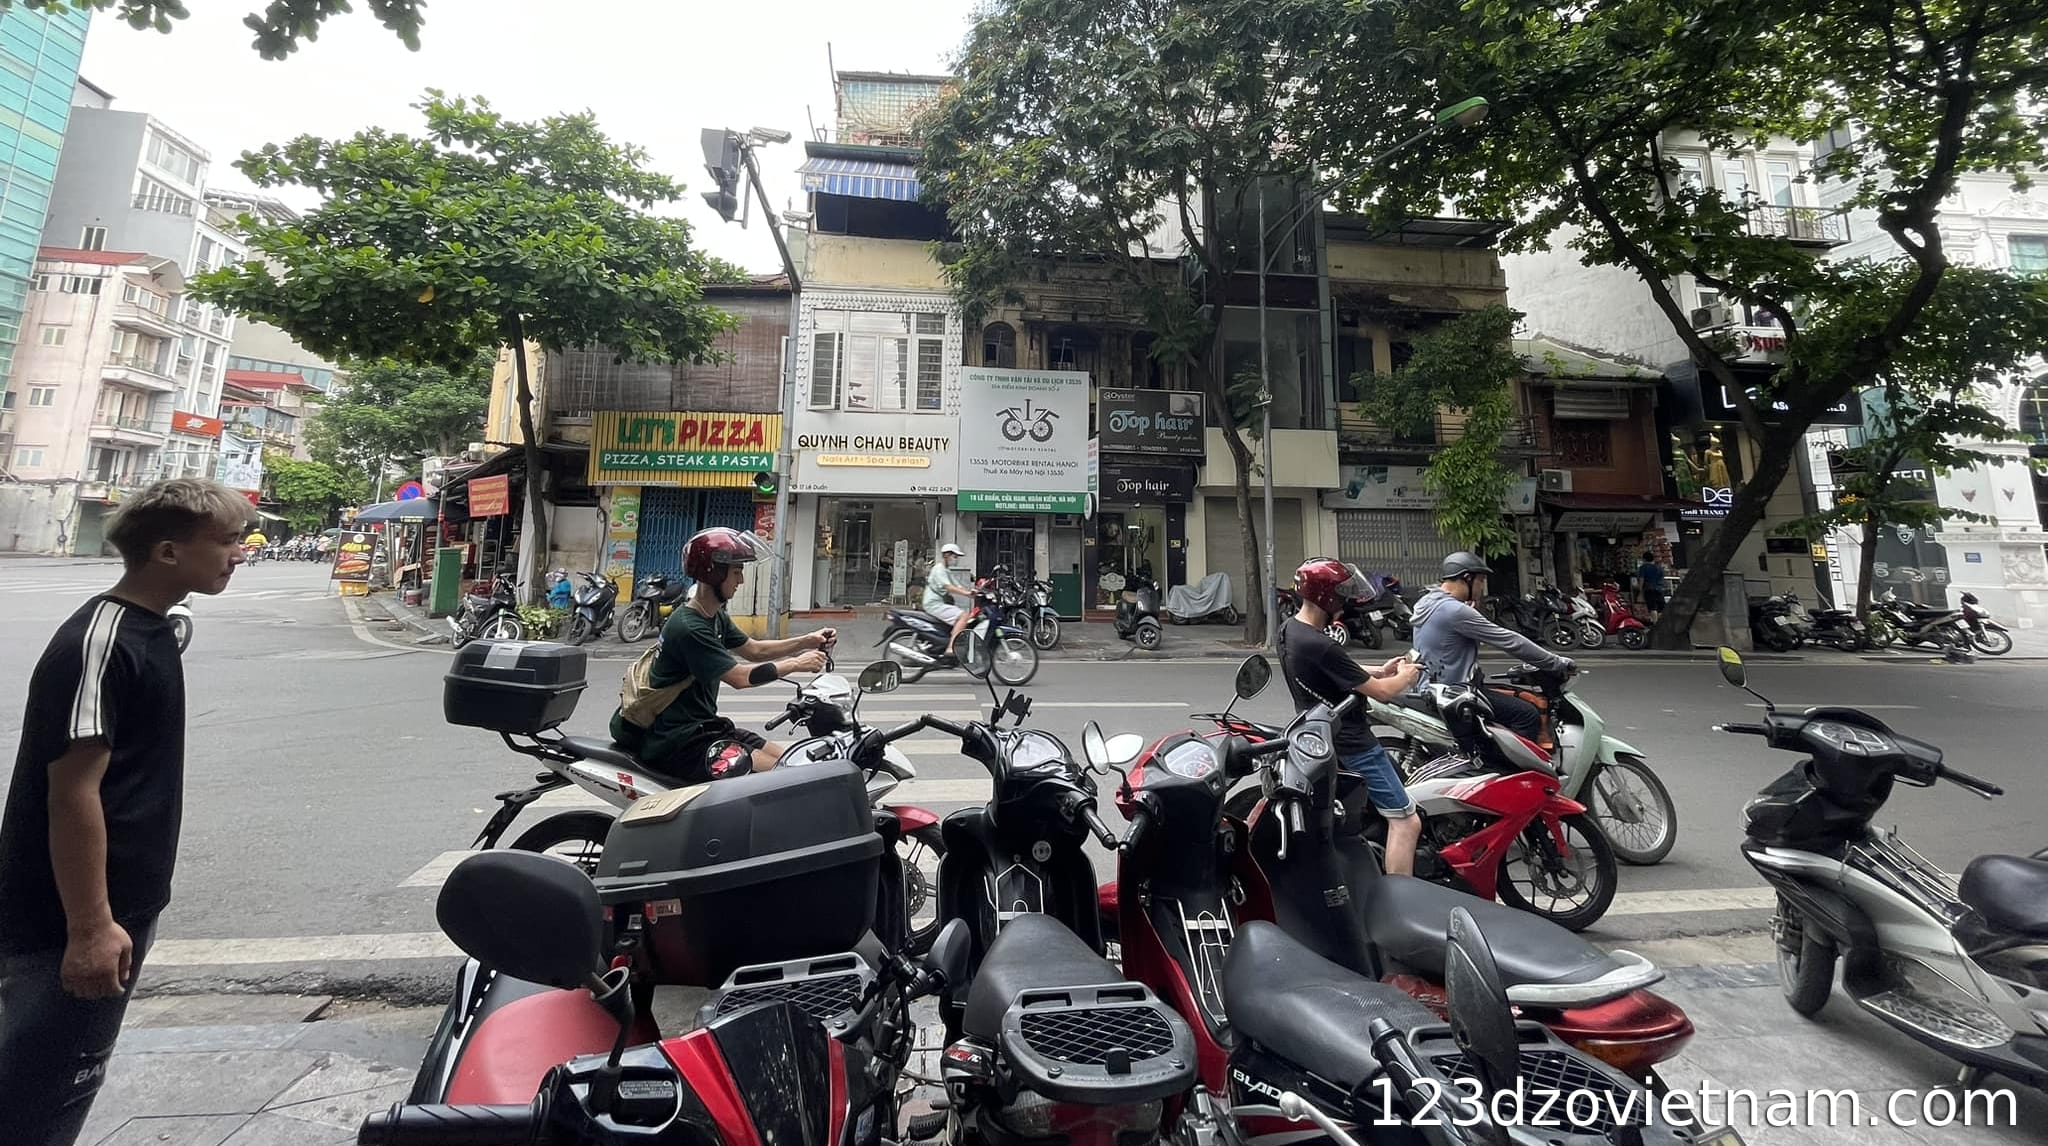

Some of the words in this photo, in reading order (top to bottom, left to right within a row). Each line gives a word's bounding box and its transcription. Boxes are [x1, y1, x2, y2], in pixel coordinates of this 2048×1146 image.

[1109, 410, 1150, 436] Top
[1155, 411, 1193, 431] hair
[618, 416, 676, 446] LET'S
[679, 419, 764, 448] PIZZA
[798, 434, 848, 449] QUYNH
[854, 435, 894, 449] CHAU
[899, 437, 950, 451] BEAUTY
[604, 453, 655, 467] PIZZA,
[657, 454, 704, 466] STEAK
[708, 455, 717, 466] &
[722, 455, 769, 467] PASTA
[991, 459, 1030, 467] MOTORBIKE
[1117, 479, 1142, 494] Top
[1145, 479, 1170, 491] hair
[1233, 1068, 1283, 1101] BLAD
